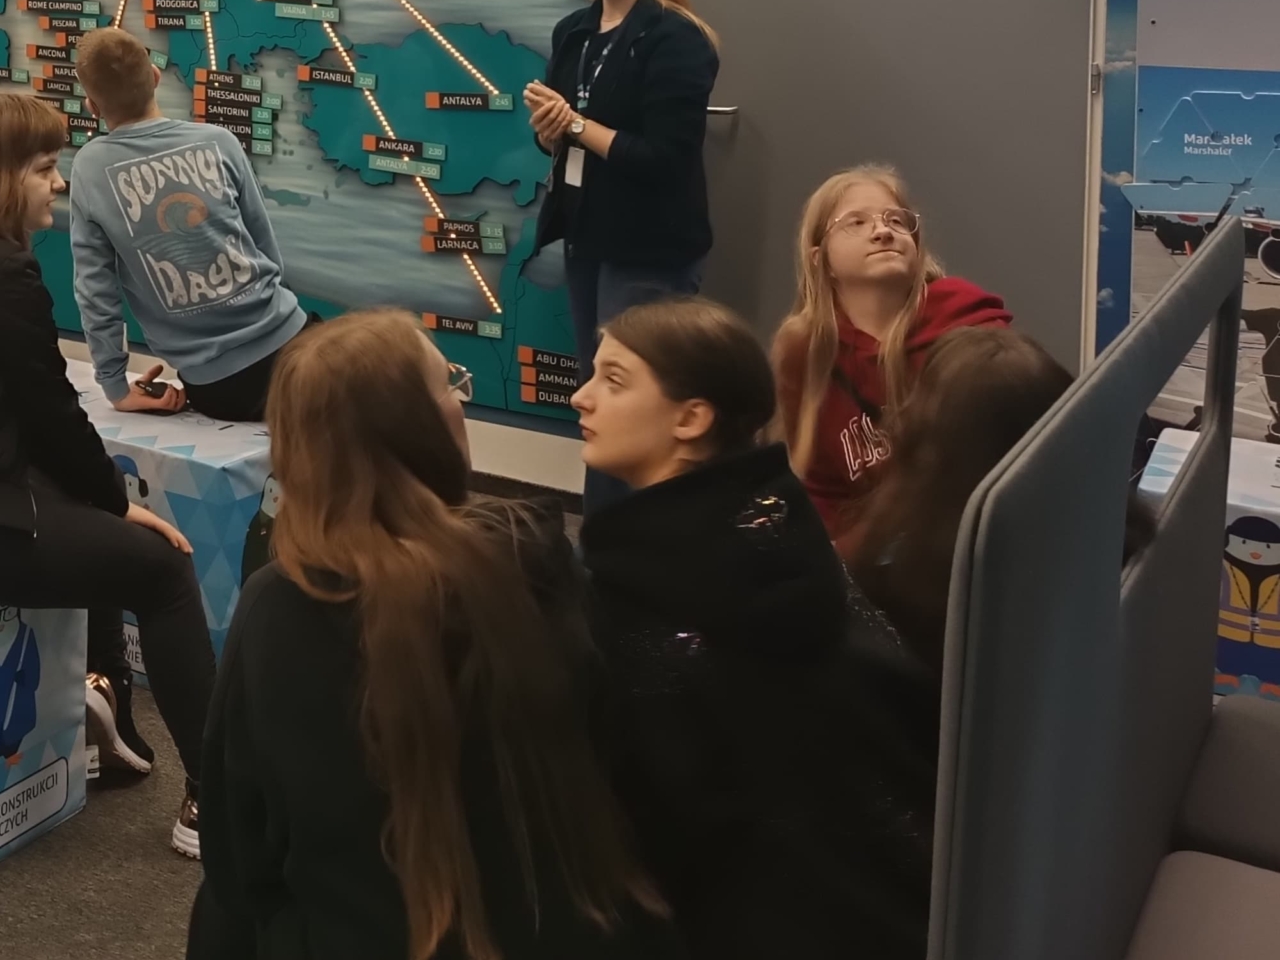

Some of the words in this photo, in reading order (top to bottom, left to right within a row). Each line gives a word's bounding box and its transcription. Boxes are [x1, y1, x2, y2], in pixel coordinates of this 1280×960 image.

[28, 1, 47, 10] ROME
[48, 2, 82, 12] CIAMPINO
[156, 0, 198, 9] PODGORICA
[282, 6, 307, 16] VARNA
[52, 20, 77, 28] PESCARA
[158, 17, 185, 27] TIRANA
[38, 49, 66, 58] ANCONA
[209, 73, 234, 84] ATHENS
[312, 70, 353, 84] ISTANBUL
[47, 82, 70, 91] LAMEZIA
[207, 89, 260, 103] THESSALONIKI
[443, 96, 483, 106] ANTALYA
[208, 105, 249, 117] SANTORINI
[70, 118, 97, 128] CATANIA
[1184, 133, 1252, 146] Marałek
[379, 141, 415, 153] ANKARA
[376, 158, 407, 170] ANTALYA
[117, 149, 224, 223] SUNNY
[443, 222, 475, 232] PAPHOS
[437, 240, 479, 250] LARNACA
[442, 320, 455, 329] TEL
[456, 321, 474, 331] AVIV
[536, 353, 557, 364] ABU
[538, 373, 577, 387] AMMAN
[539, 392, 569, 404] DUBAI
